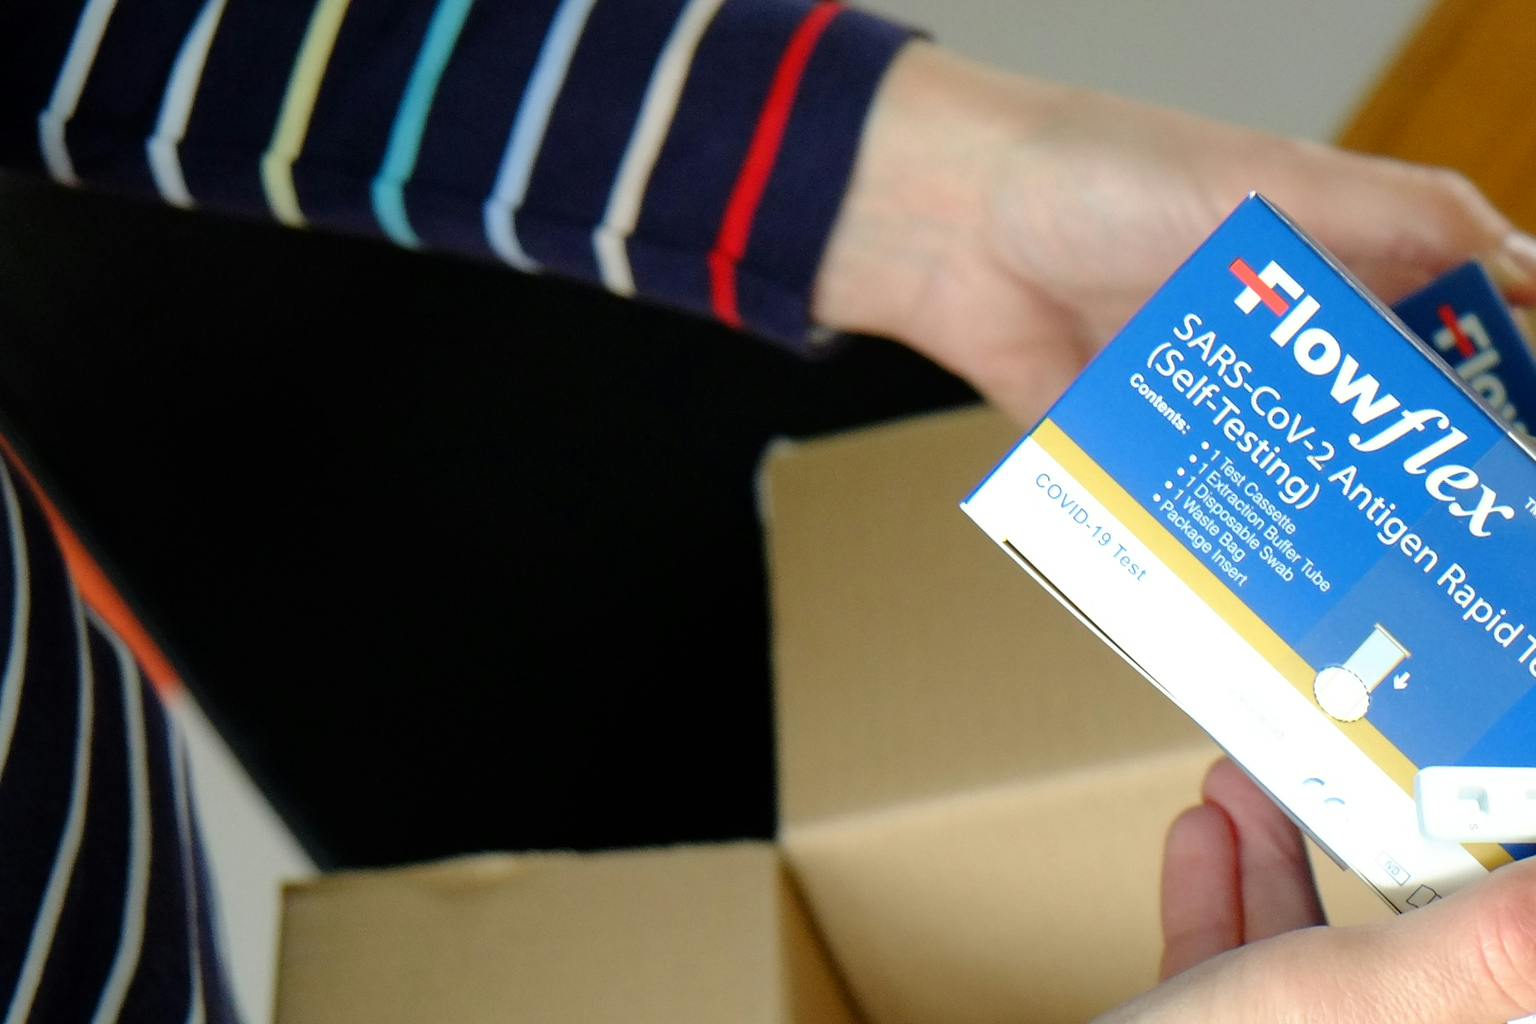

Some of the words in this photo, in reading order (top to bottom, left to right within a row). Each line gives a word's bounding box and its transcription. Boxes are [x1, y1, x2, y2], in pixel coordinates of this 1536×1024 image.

[1129, 373, 1191, 435] Contents:
[1229, 258, 1516, 538] Flowflex
[1433, 304, 1529, 437] Flo
[1147, 342, 1321, 510] (Self-Testing)
[1036, 473, 1112, 546] COVID-19
[1113, 544, 1147, 581] Test
[1173, 313, 1336, 471] SARS-CoV-2
[1328, 465, 1439, 573] Antigen
[1437, 563, 1525, 648] Rapid
[1174, 489, 1184, 500] 1
[1183, 496, 1220, 536] Waste
[1219, 532, 1246, 563] Bag
[1186, 476, 1197, 488] 1
[1194, 485, 1260, 550] Disposable
[1259, 546, 1294, 582] Swab
[1199, 463, 1209, 475] 1
[1206, 471, 1265, 530] Extraction
[1264, 525, 1302, 563] Buffer
[1301, 559, 1331, 592] Tube
[1211, 449, 1221, 461] 1
[1220, 456, 1246, 487] Test
[1244, 482, 1297, 535] Cassette
[1160, 500, 1213, 554] Package
[1211, 549, 1248, 587] Insert
